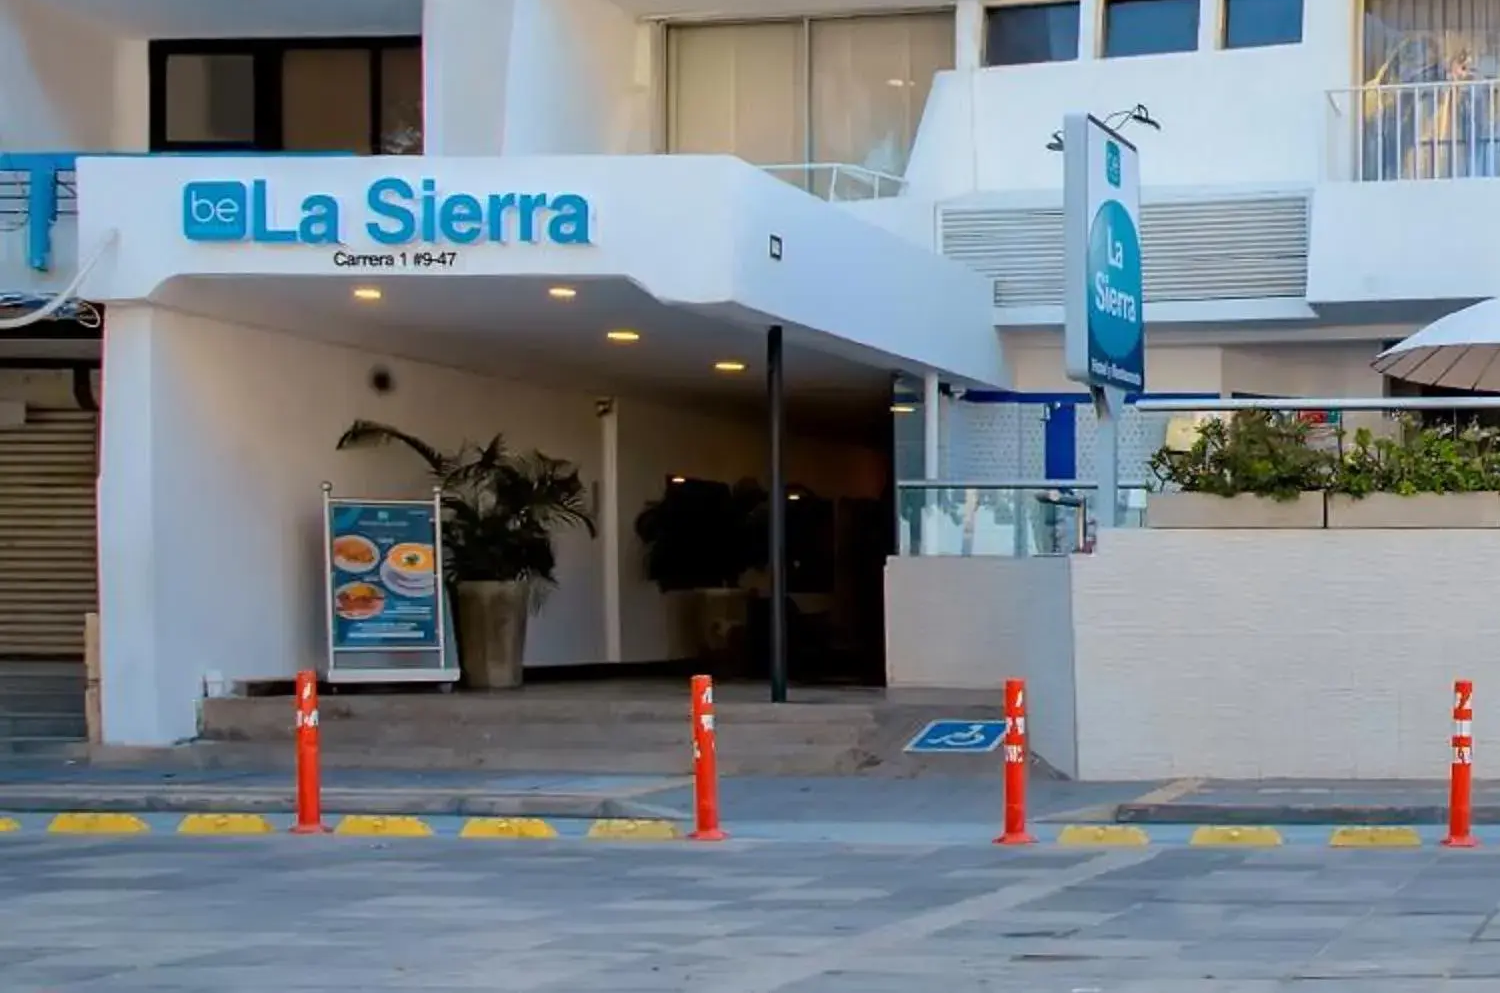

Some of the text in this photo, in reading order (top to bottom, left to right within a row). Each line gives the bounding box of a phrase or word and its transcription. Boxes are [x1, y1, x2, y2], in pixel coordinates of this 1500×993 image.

[190, 176, 591, 245] be La Sierra
[333, 250, 457, 267] Carrera 1 #9-47
[1107, 224, 1123, 270] La
[1095, 270, 1137, 323] Sierra
